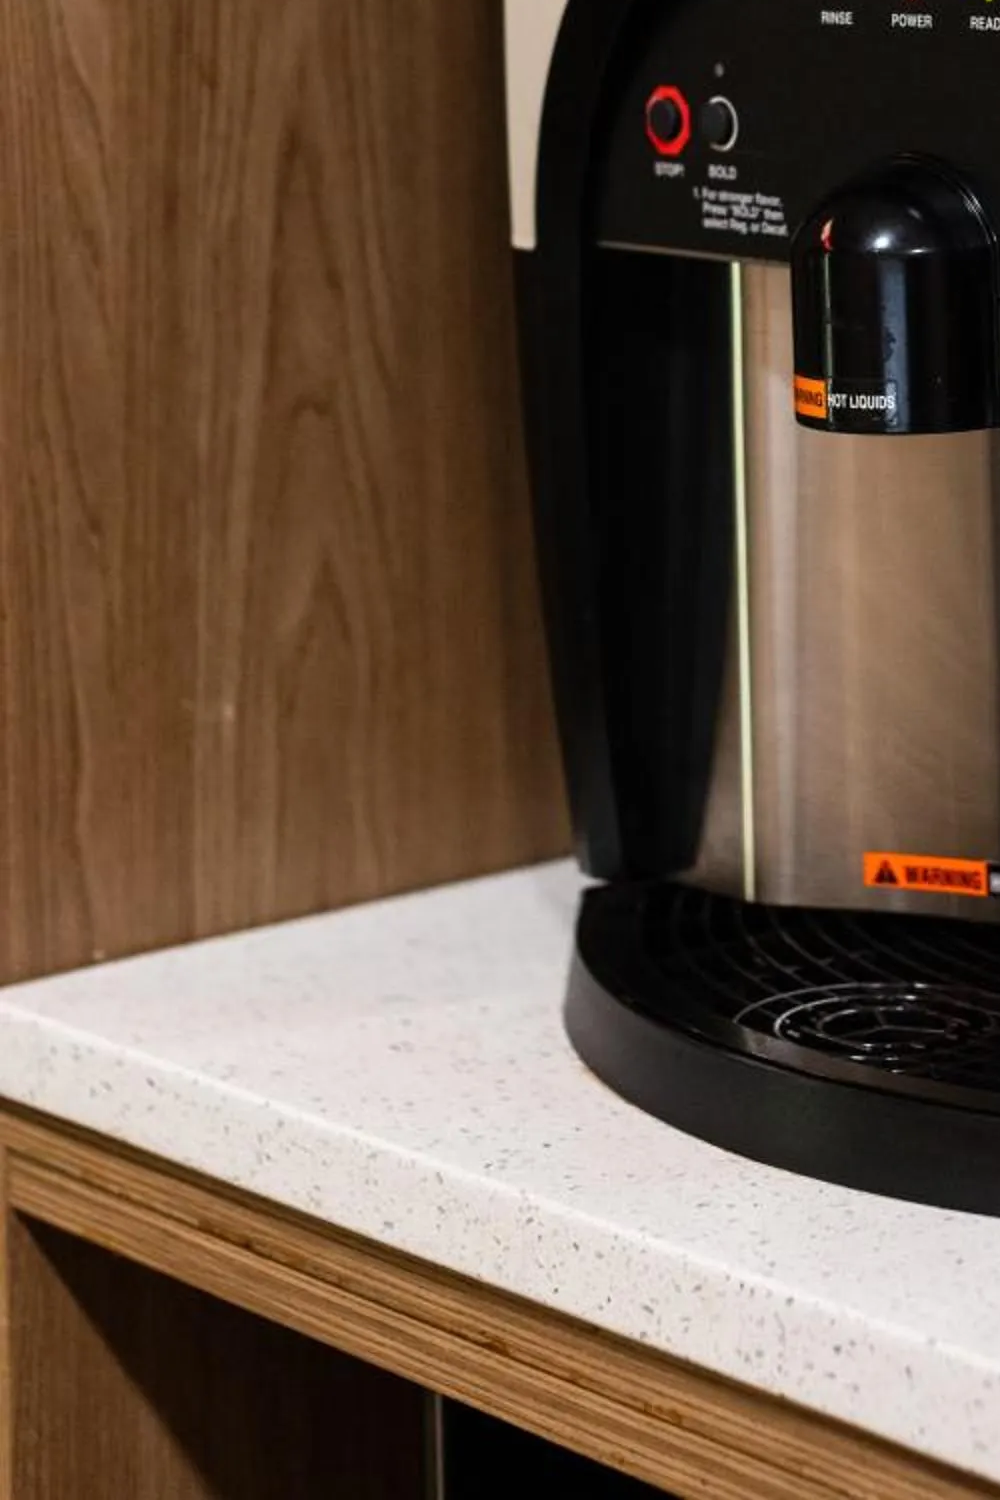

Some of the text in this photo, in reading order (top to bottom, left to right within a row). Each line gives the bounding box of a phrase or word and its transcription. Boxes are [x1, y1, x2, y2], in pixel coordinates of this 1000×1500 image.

[820, 10, 853, 25] RINSE
[891, 13, 933, 28] POWER
[654, 161, 685, 177] STOP
[708, 163, 738, 180] BOLD
[828, 393, 847, 408] HOT
[849, 395, 895, 410] LIQUIDS
[905, 865, 982, 890] WARNING
